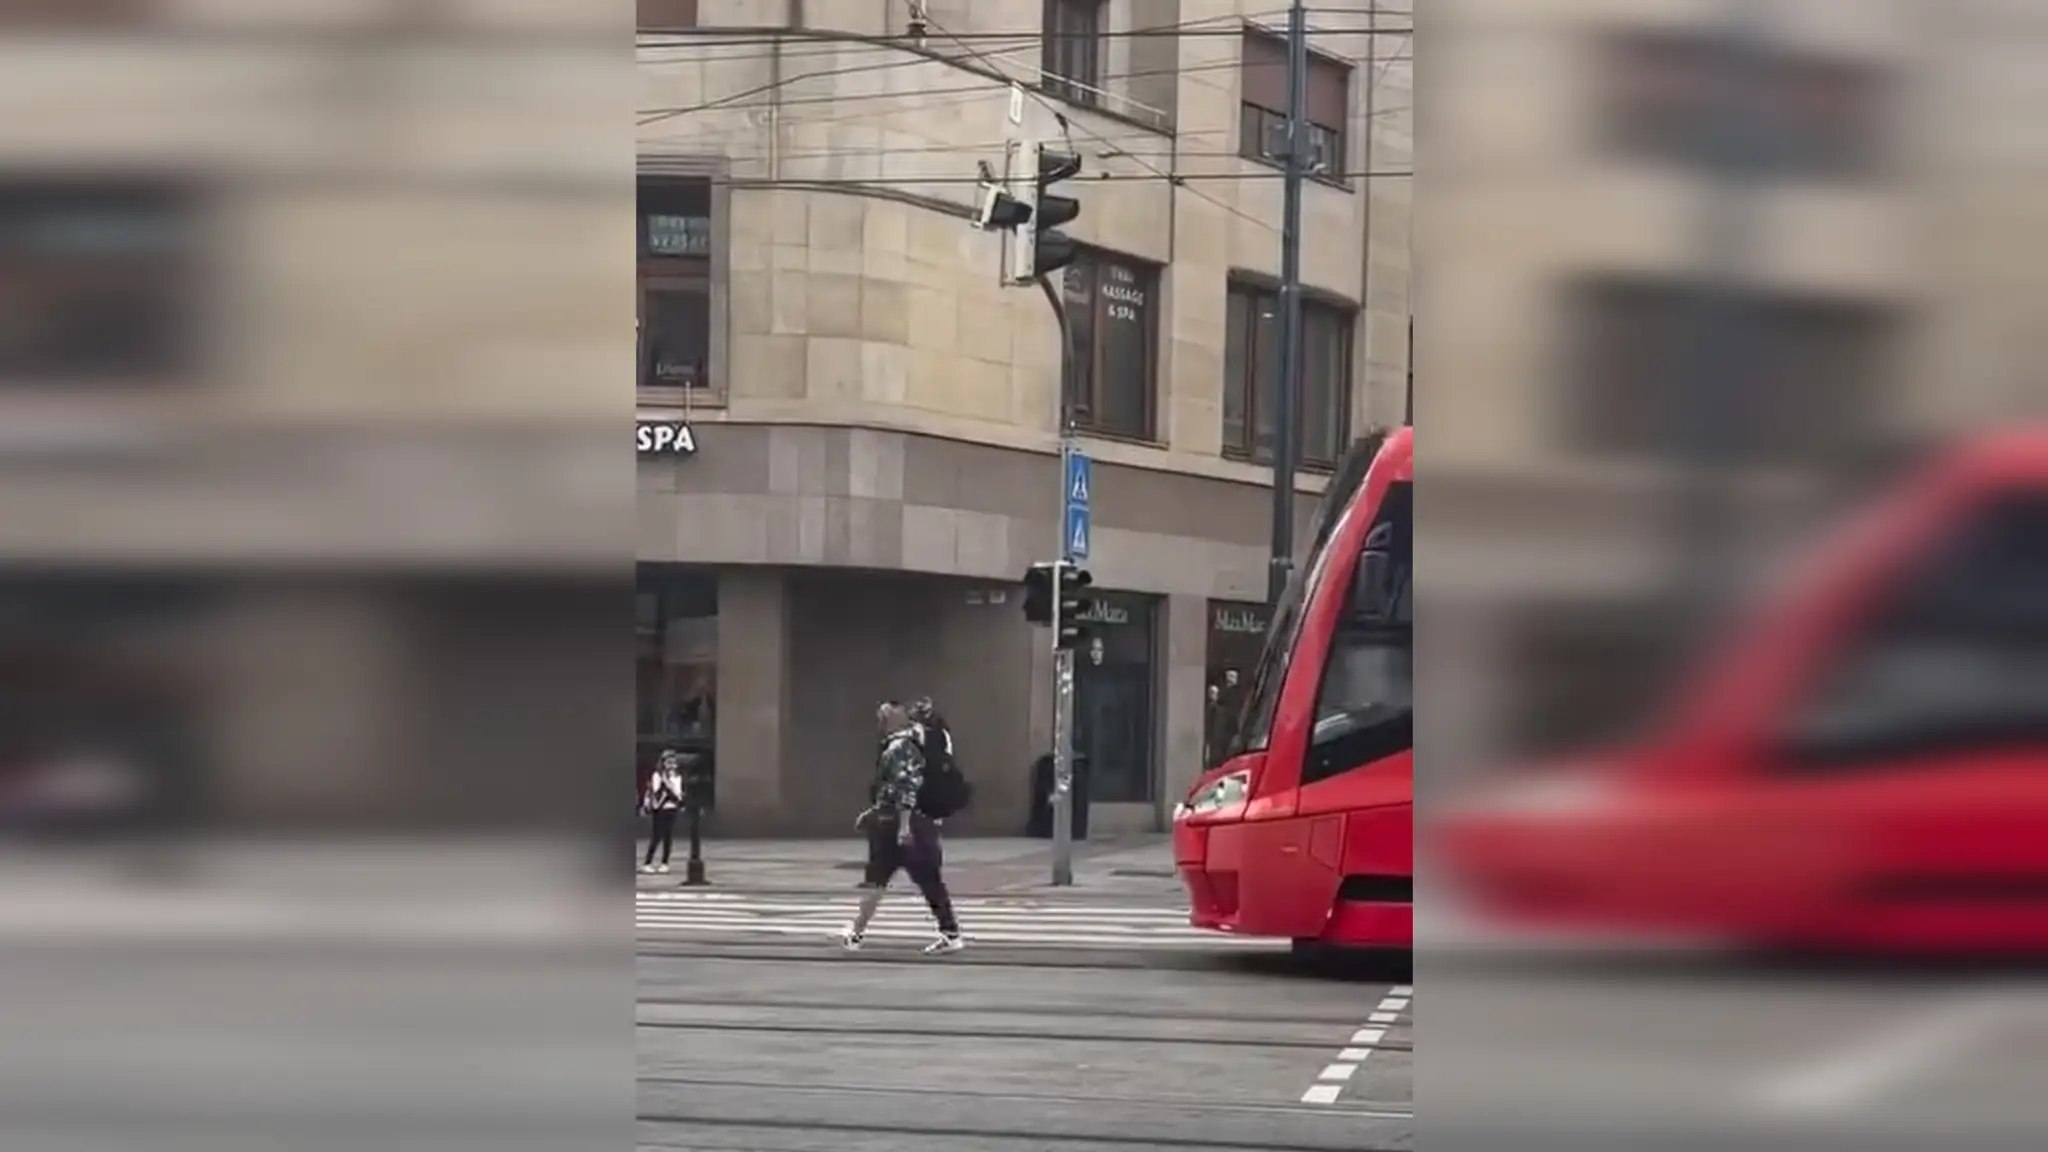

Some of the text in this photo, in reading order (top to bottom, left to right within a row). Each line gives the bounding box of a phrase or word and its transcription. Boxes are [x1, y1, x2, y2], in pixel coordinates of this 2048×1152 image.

[1116, 306, 1135, 320] SPA
[637, 424, 696, 452] SPA
[1214, 608, 1266, 632] MaxMar
